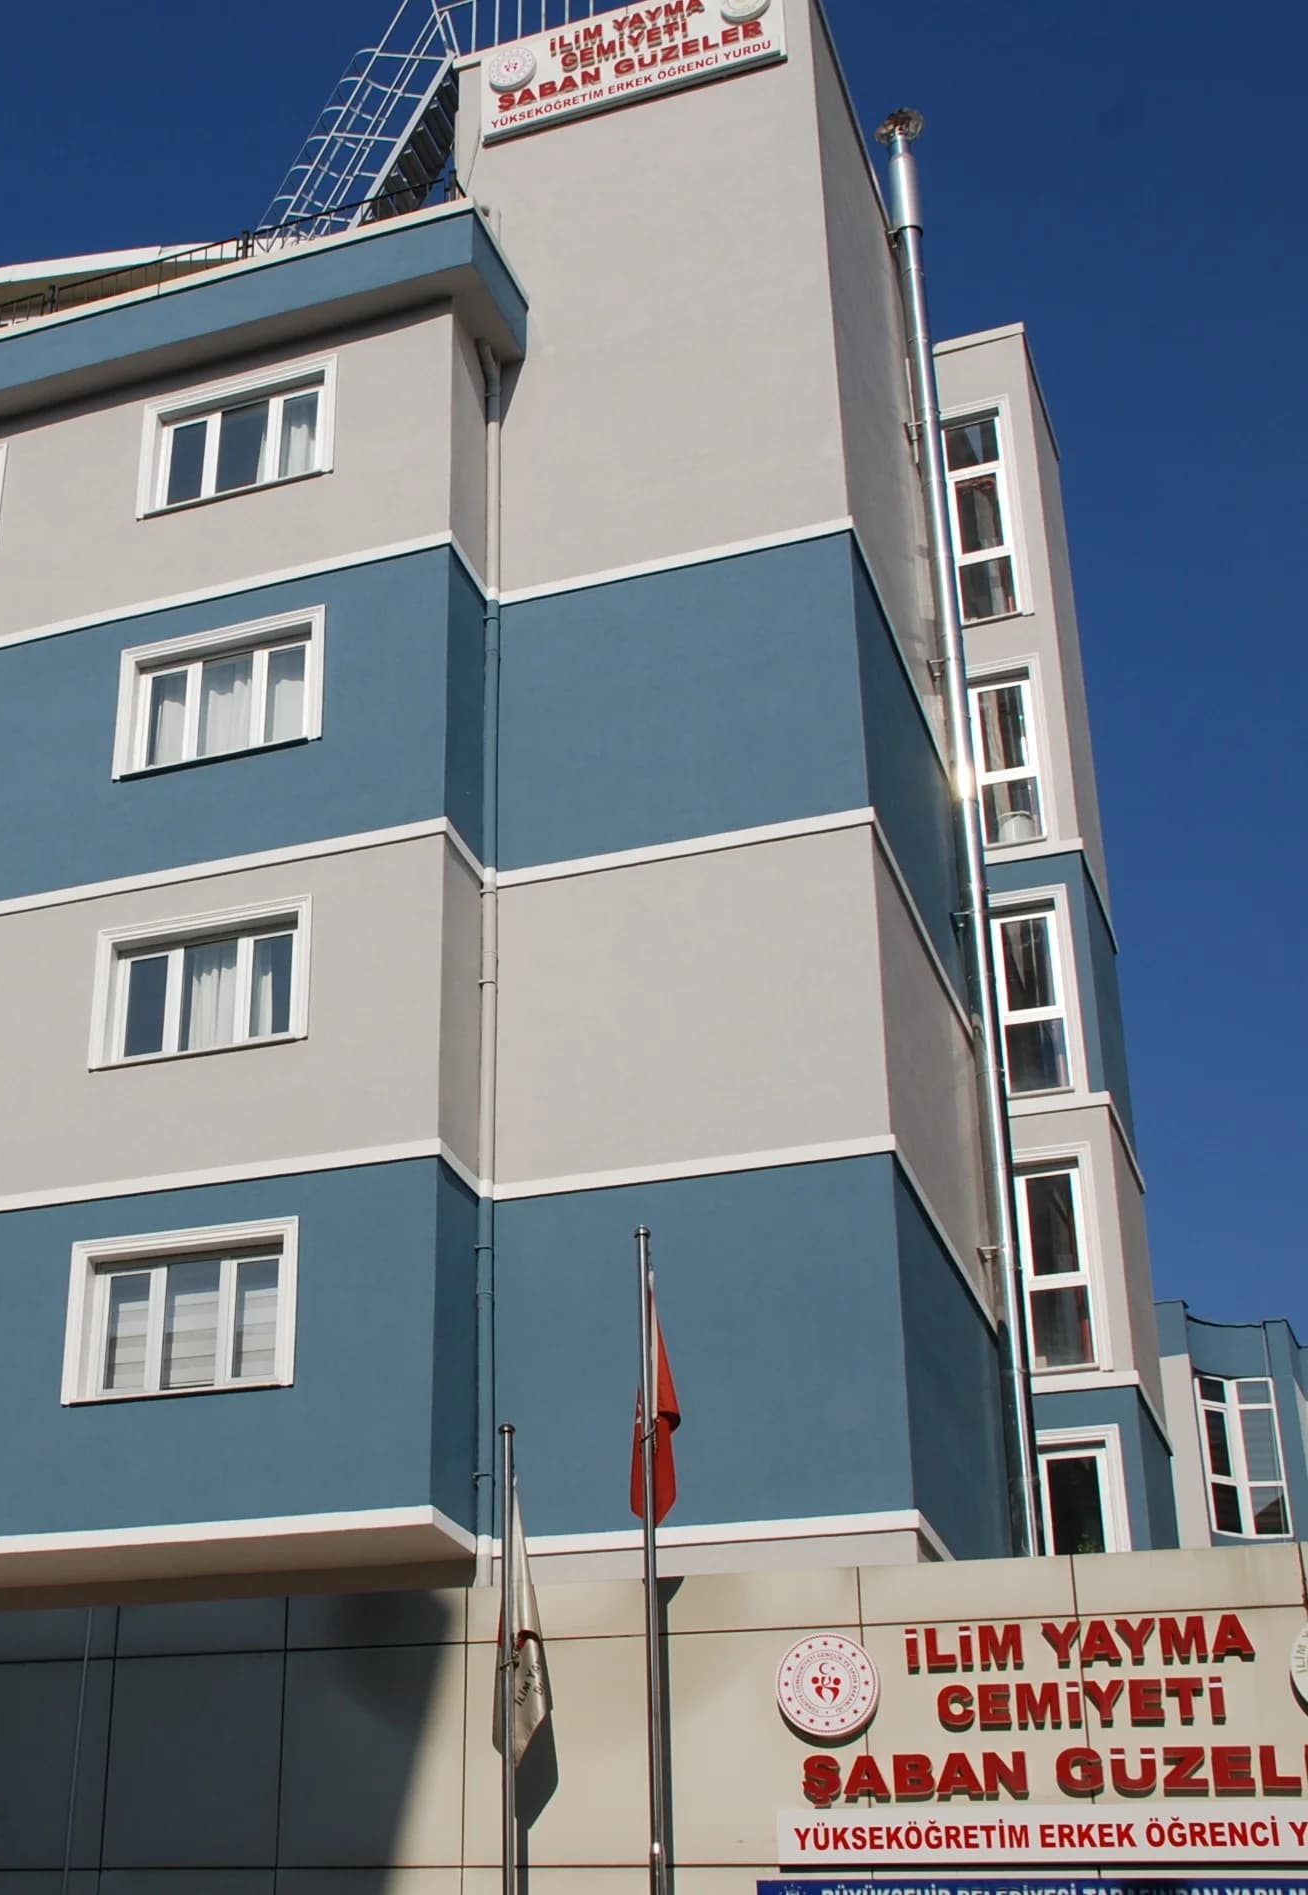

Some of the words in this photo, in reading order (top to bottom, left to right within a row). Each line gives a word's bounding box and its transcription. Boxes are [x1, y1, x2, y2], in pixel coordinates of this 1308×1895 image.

[550, 24, 603, 55] İLİM
[613, 0, 704, 35] YAYMA
[561, 19, 688, 70] CEMİYETİ
[614, 20, 763, 77] GÜZELER
[492, 88, 604, 129] YÜKSEKÖĞRETİM
[608, 74, 653, 95] ERKEK
[657, 53, 719, 80] ÖĞRENCİ
[724, 40, 771, 61] YURDU
[498, 67, 601, 112] ŞABAN
[905, 1623, 1024, 1674] İLİM
[1041, 1613, 1256, 1667] YAYMA
[937, 1676, 1227, 1731] CEMİYETİ
[802, 1751, 1030, 1808] ŞABAN
[1056, 1744, 1308, 1798] GÜZEL
[794, 1819, 1030, 1850] YÜKSEKÖĞRETİM
[1039, 1823, 1135, 1849] ERKEK
[1145, 1815, 1280, 1848] ÖĞRENCİ
